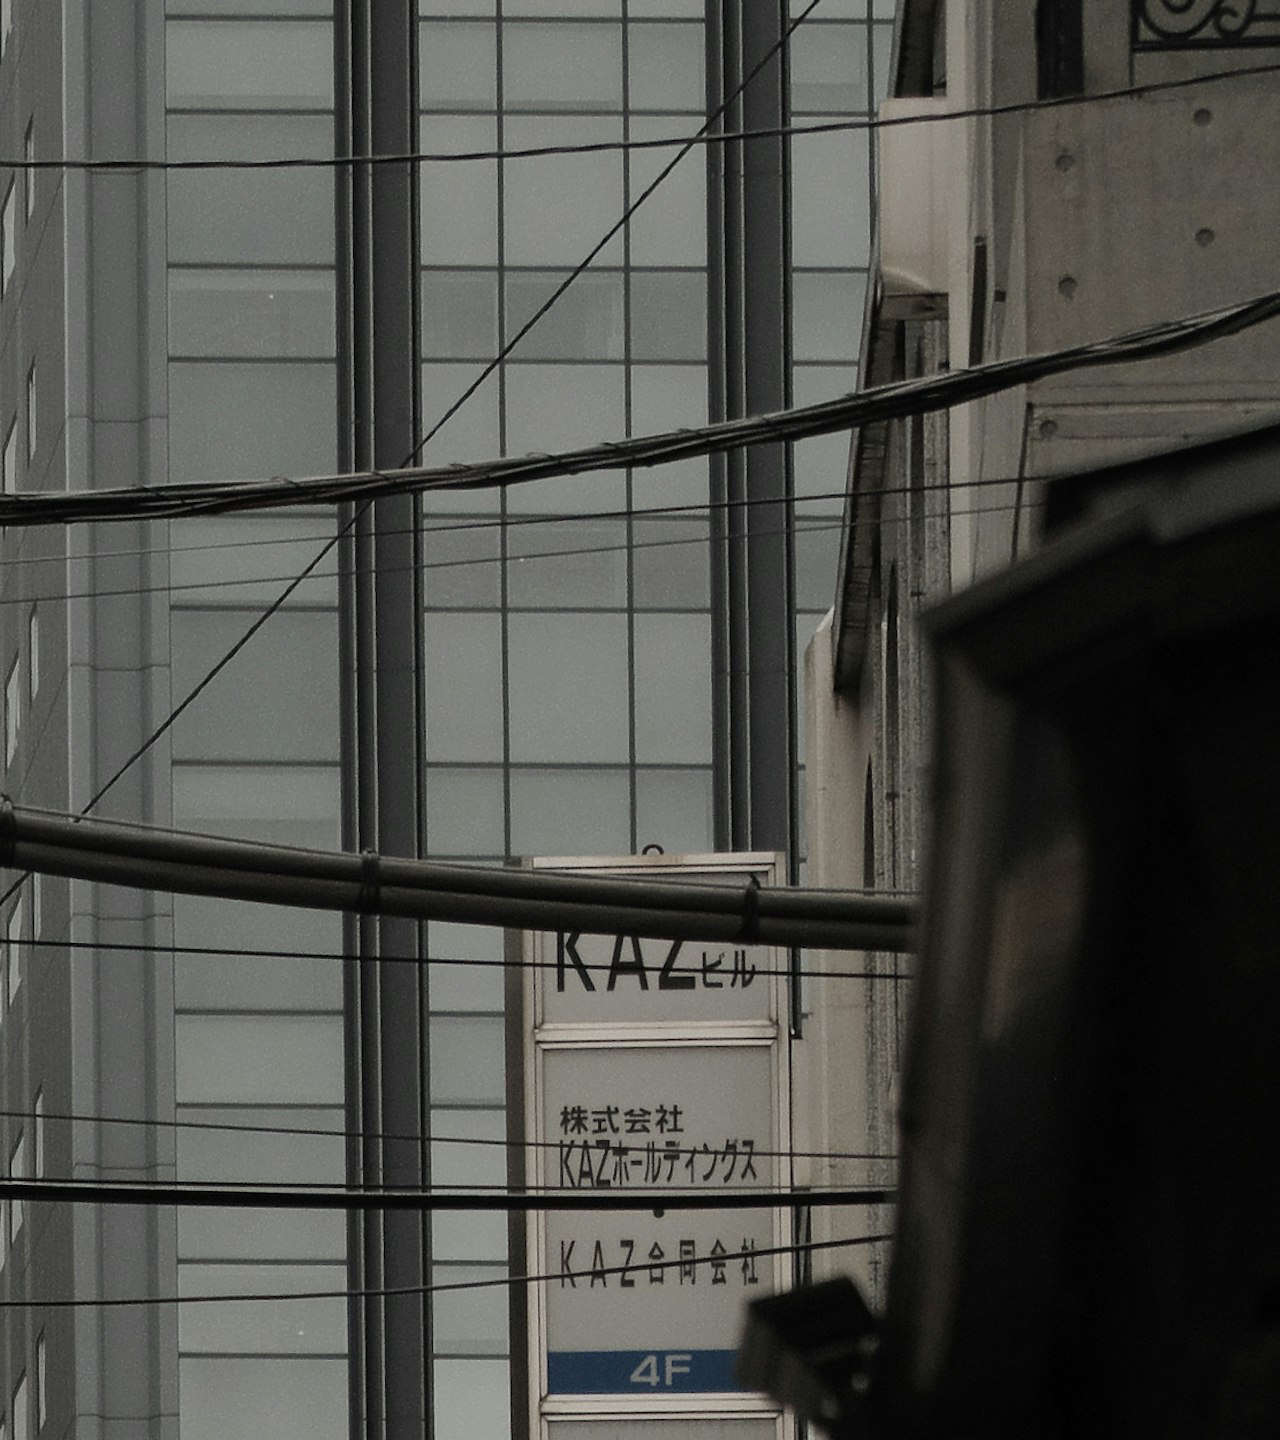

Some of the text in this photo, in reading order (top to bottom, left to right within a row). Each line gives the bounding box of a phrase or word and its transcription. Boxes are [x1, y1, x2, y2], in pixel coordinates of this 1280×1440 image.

[559, 1105, 683, 1135] 株式会社
[559, 1139, 758, 1187] KAZホールディングス
[630, 1354, 692, 1387] 4F
